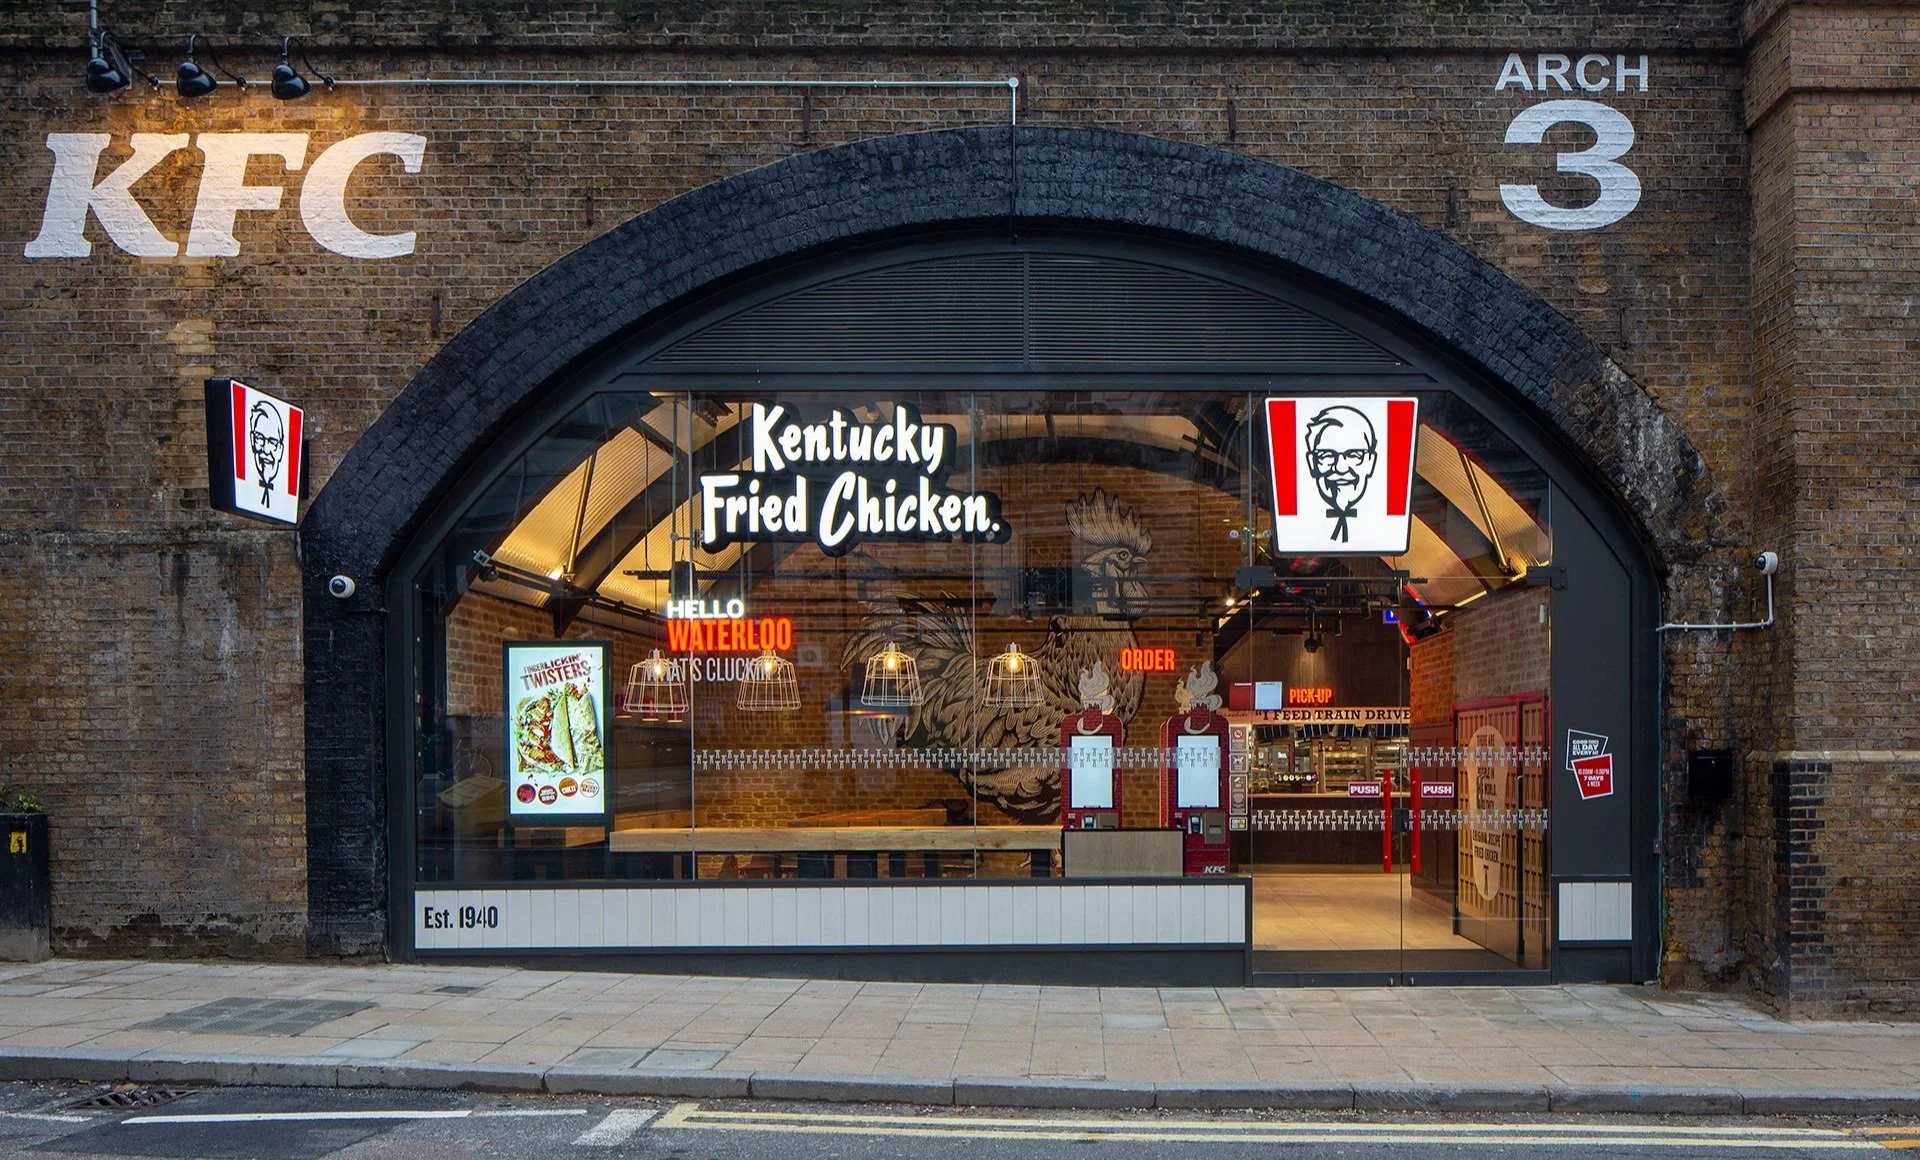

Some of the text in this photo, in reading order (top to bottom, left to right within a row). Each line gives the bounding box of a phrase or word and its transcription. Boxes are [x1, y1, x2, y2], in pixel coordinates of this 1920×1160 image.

[1494, 53, 1649, 92] ARCH
[1500, 99, 1642, 231] 3
[24, 132, 427, 259] KFC
[752, 402, 945, 475] Kentucky
[700, 471, 1001, 548] Fried Chicken.
[666, 599, 745, 619] HELLO
[667, 616, 793, 652] WATERLOO
[1121, 648, 1175, 671] ORDER
[520, 659, 592, 691] TWISTERS
[1289, 688, 1332, 704] PICK-UP
[1273, 709, 1312, 720] FEED
[1315, 709, 1361, 720] TRAIN
[1350, 785, 1379, 794] PUSH
[1423, 785, 1452, 794] PUSH
[1204, 865, 1226, 874] KFC
[424, 906, 498, 929] Est. 1940
